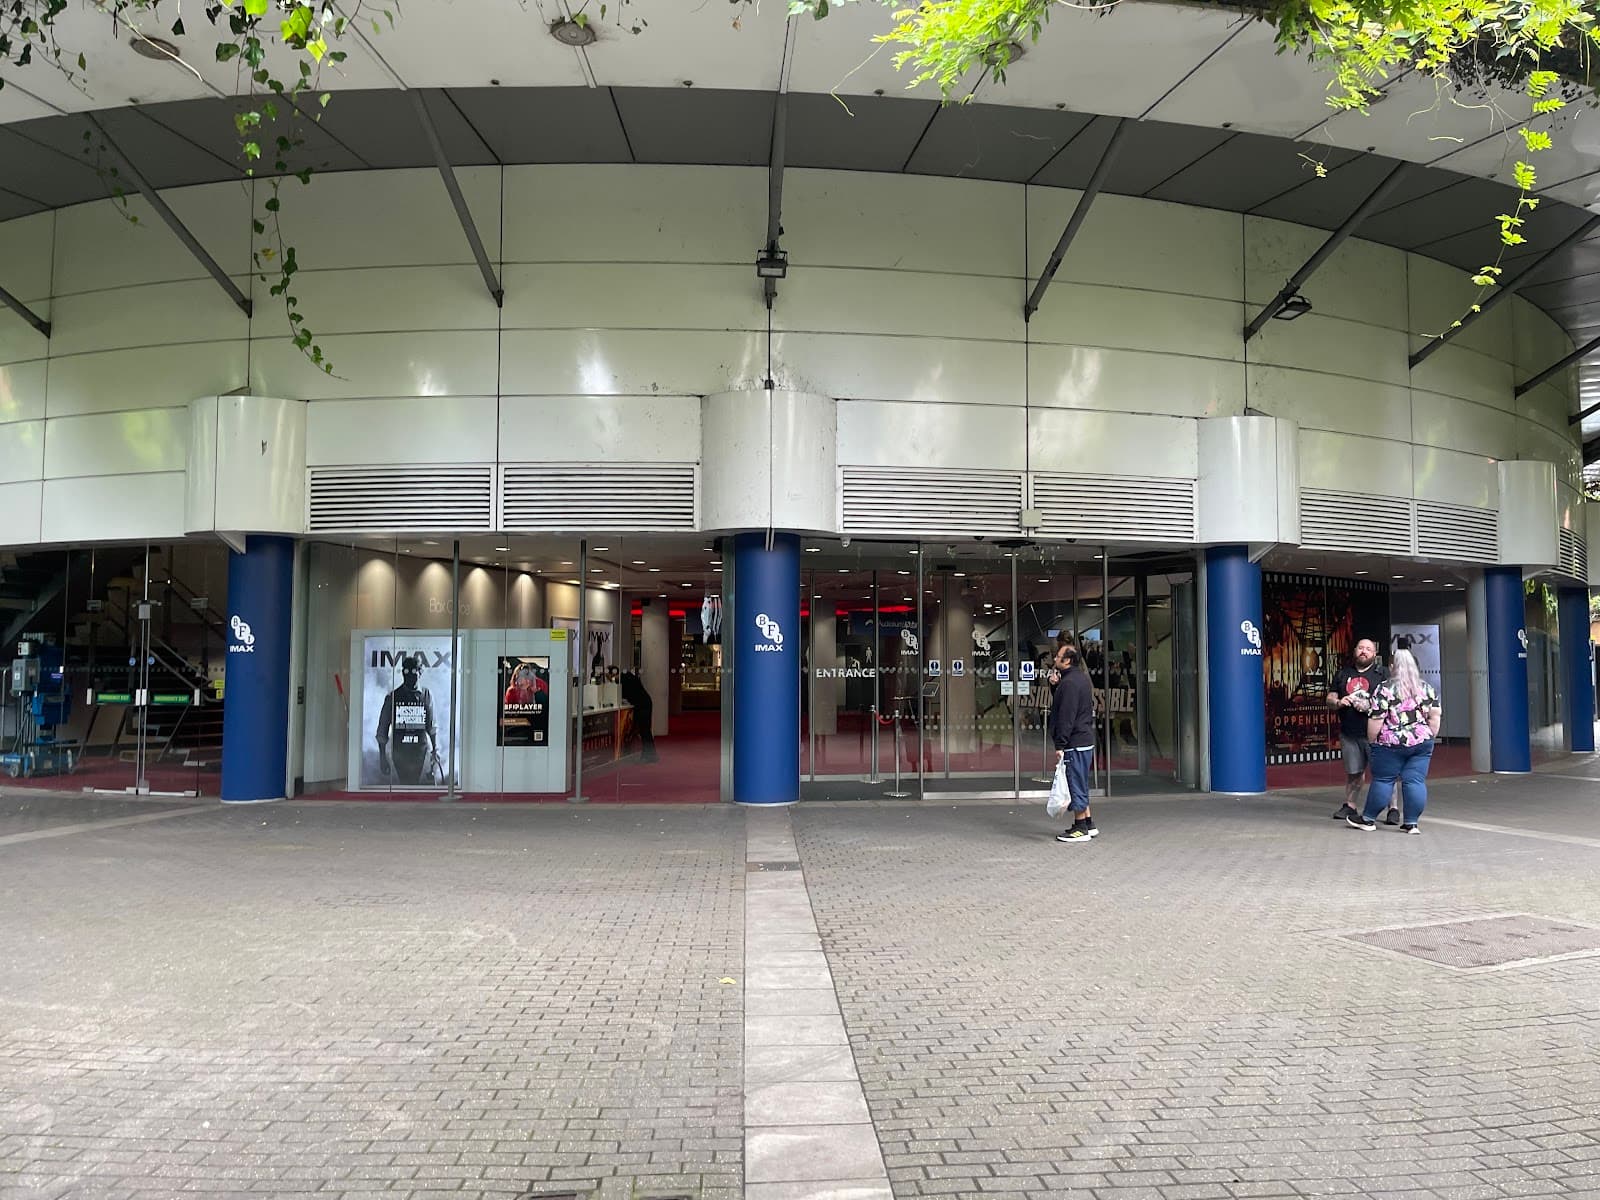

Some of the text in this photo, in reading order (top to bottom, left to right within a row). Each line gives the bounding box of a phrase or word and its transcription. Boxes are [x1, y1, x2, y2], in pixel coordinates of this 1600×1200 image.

[231, 615, 254, 644] BFI
[588, 631, 610, 642] IMAX
[756, 614, 783, 643] BFI
[1241, 620, 1261, 648] BFI
[371, 651, 451, 668] IMAX
[816, 668, 875, 678] ENTRANCE
